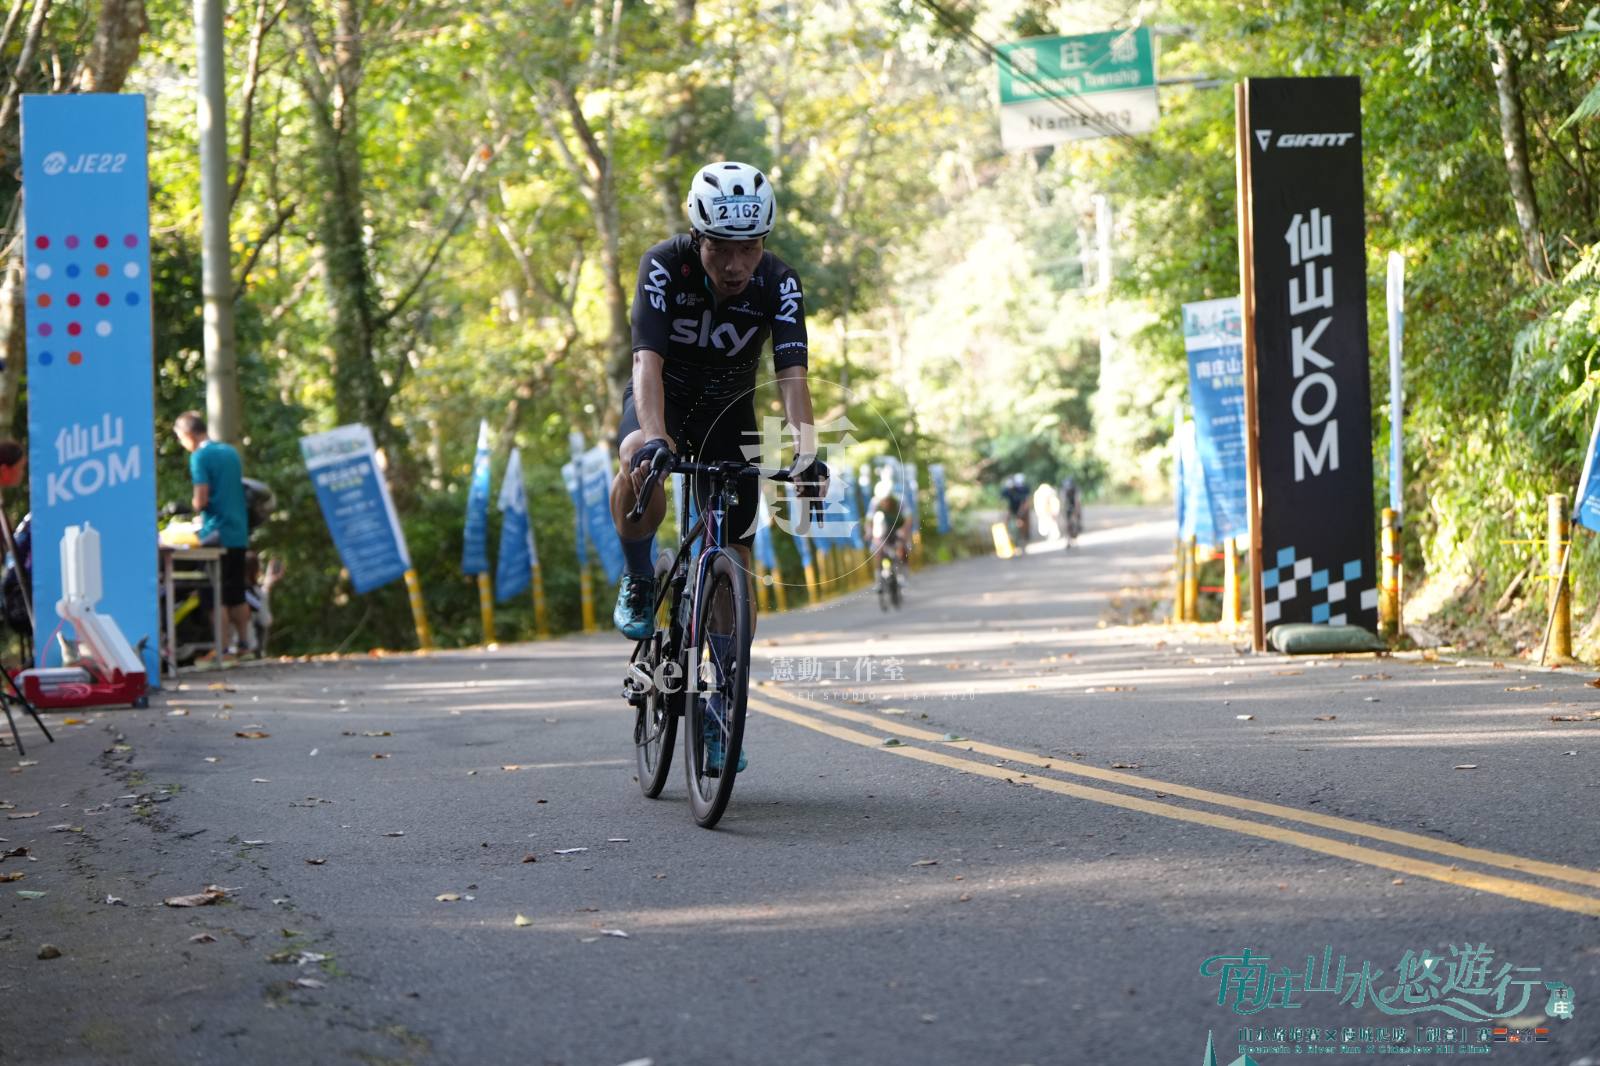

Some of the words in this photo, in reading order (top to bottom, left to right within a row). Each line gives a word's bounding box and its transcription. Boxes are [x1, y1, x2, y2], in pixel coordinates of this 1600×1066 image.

[1276, 132, 1354, 148] GIANT
[68, 153, 128, 174] JE22
[54, 412, 124, 465] 仙山
[47, 443, 141, 508] KOM
